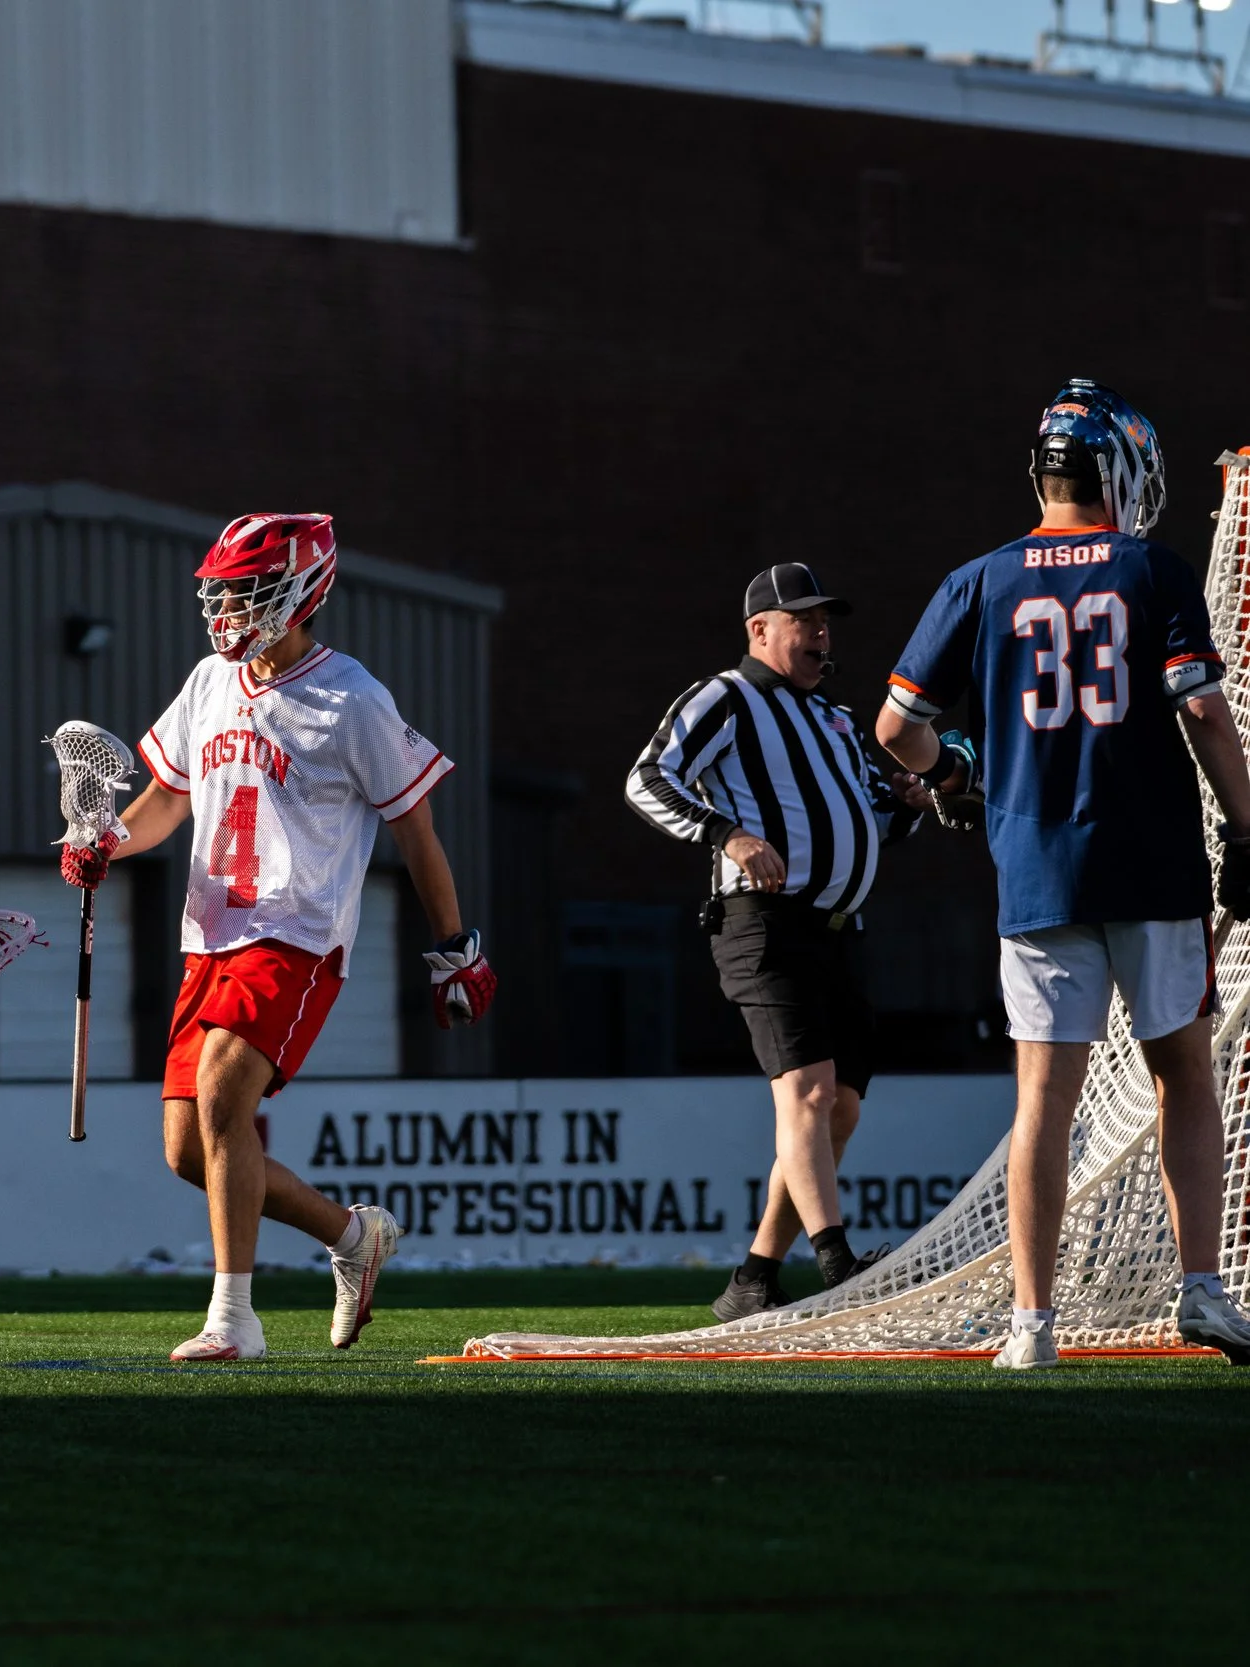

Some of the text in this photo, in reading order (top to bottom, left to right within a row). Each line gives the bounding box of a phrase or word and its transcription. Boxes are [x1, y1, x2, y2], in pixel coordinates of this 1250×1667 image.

[1024, 544, 1111, 568] BISON
[1012, 591, 1130, 731] 33
[202, 729, 292, 787] BOSTON
[208, 785, 260, 908] 4
[310, 1110, 541, 1167] ALUMNI
[562, 1109, 621, 1165] IN
